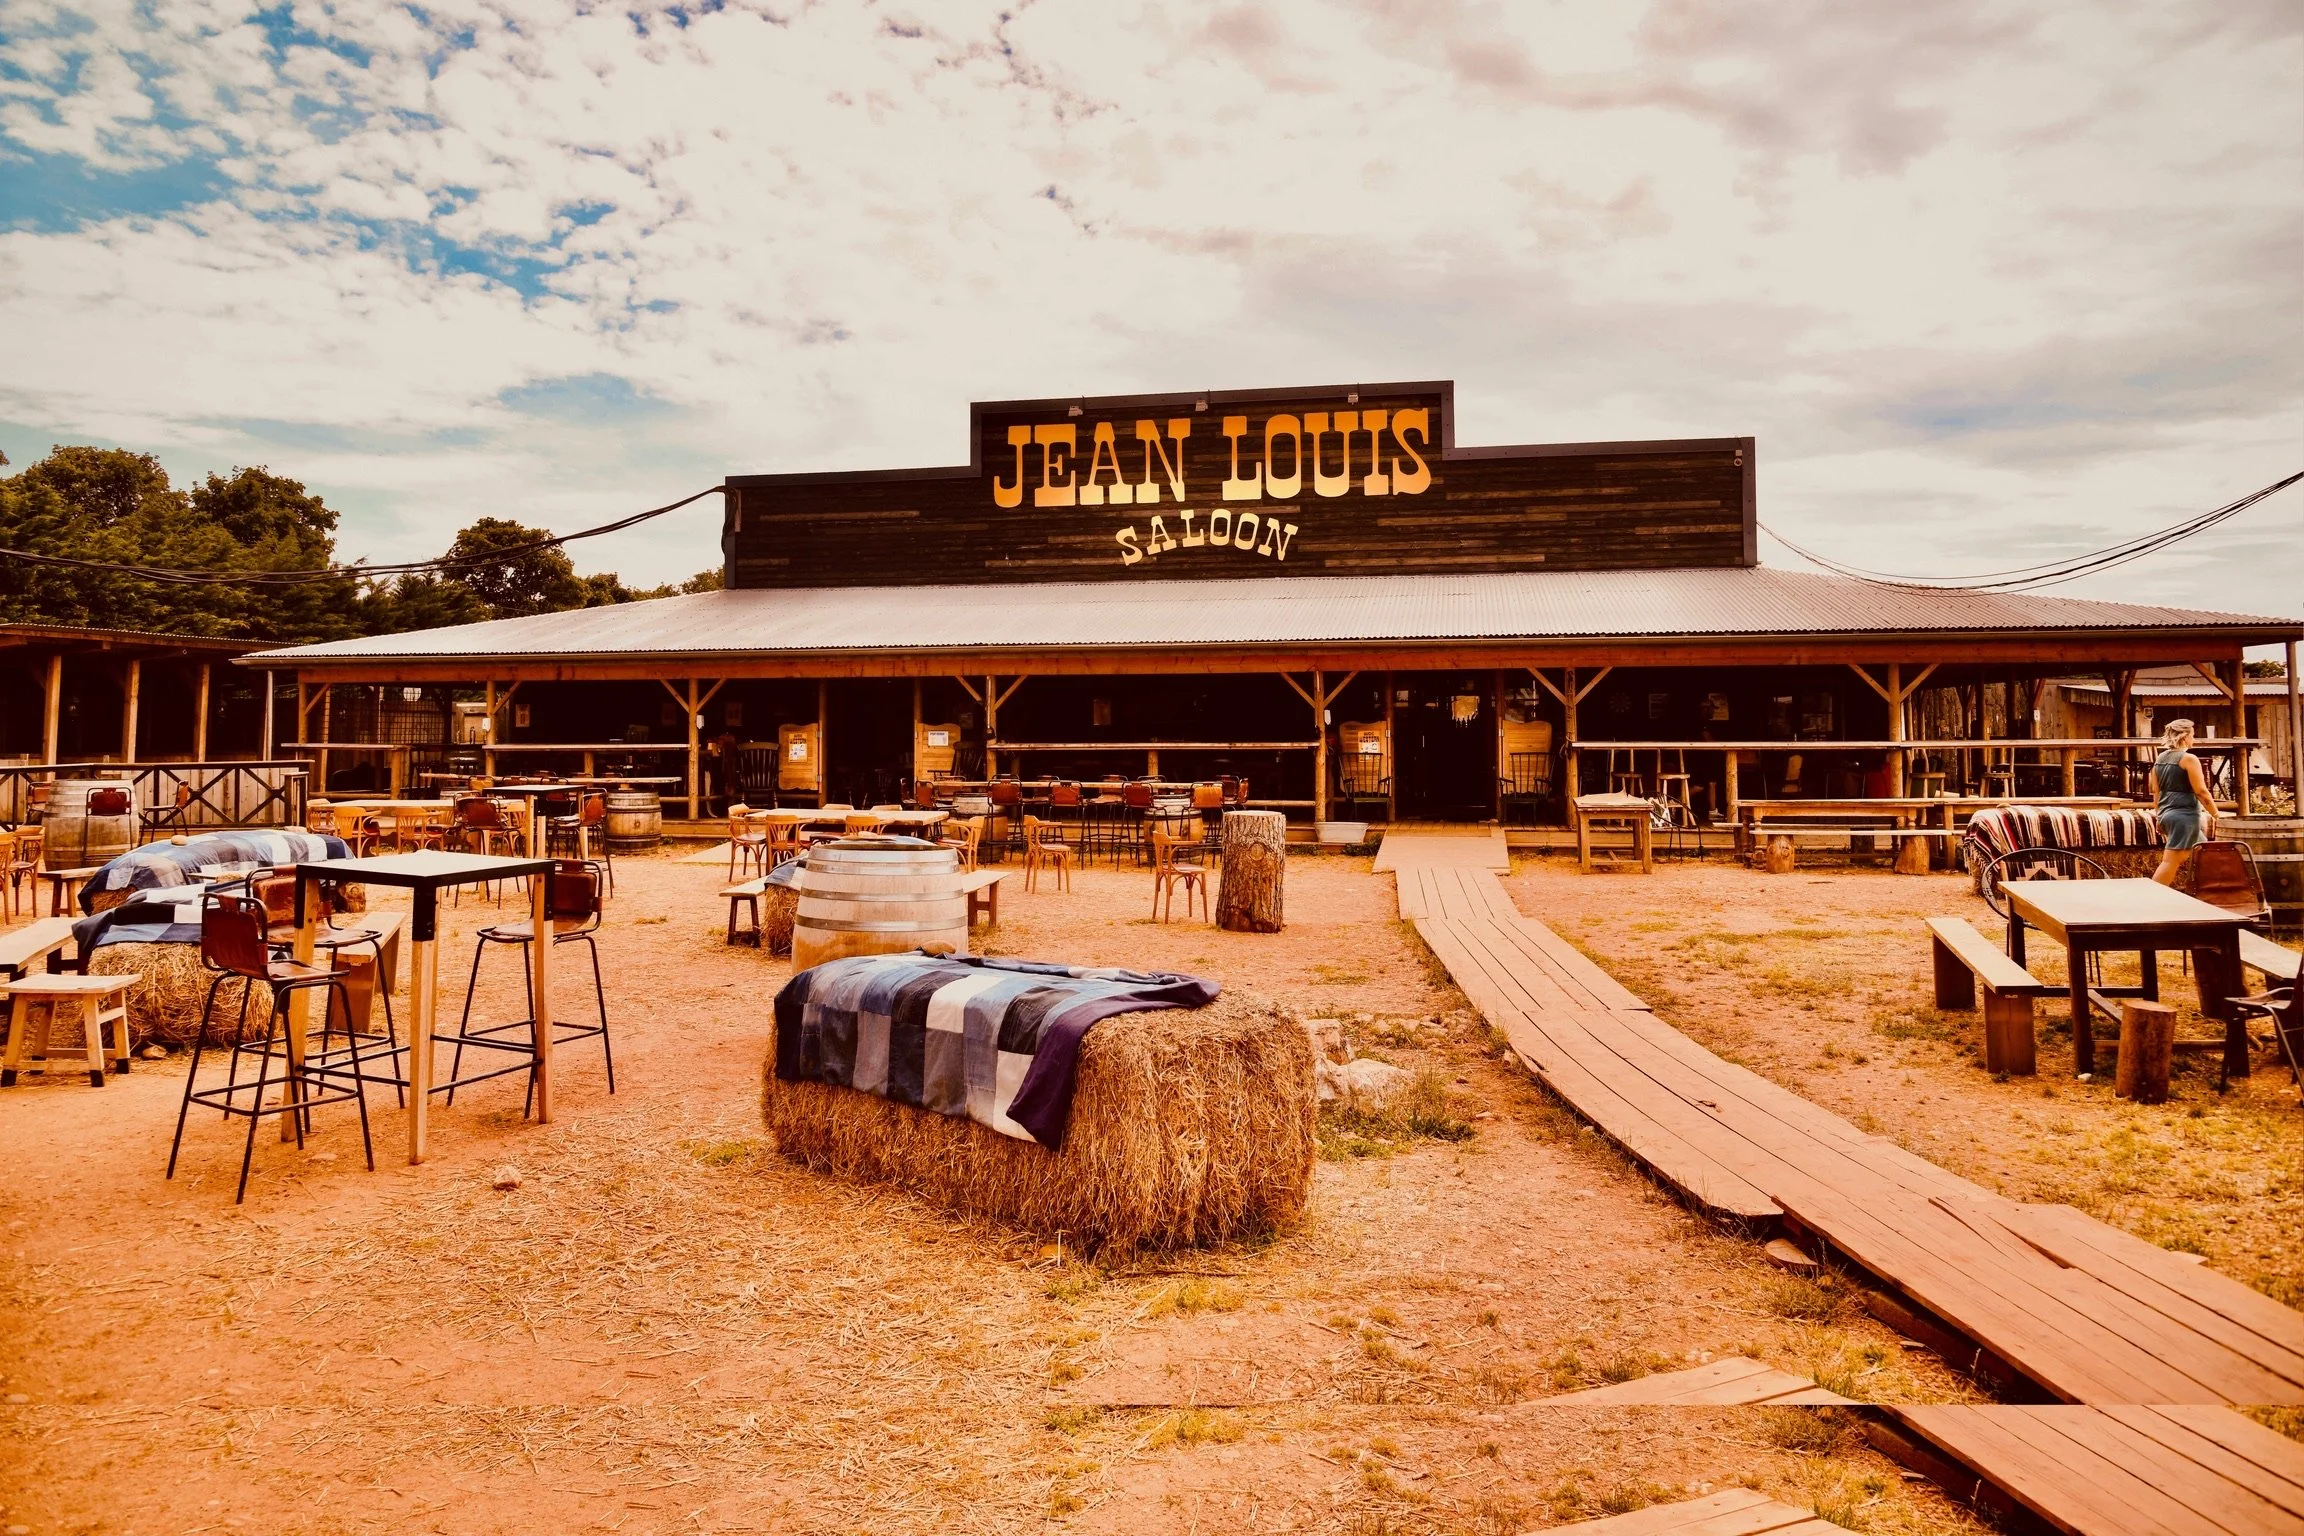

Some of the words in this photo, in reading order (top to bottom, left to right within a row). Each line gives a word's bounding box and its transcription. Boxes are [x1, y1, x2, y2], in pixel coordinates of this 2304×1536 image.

[994, 419, 1191, 508] JEAN
[1222, 408, 1432, 501] LOUIS
[1115, 508, 1299, 566] SALOON
